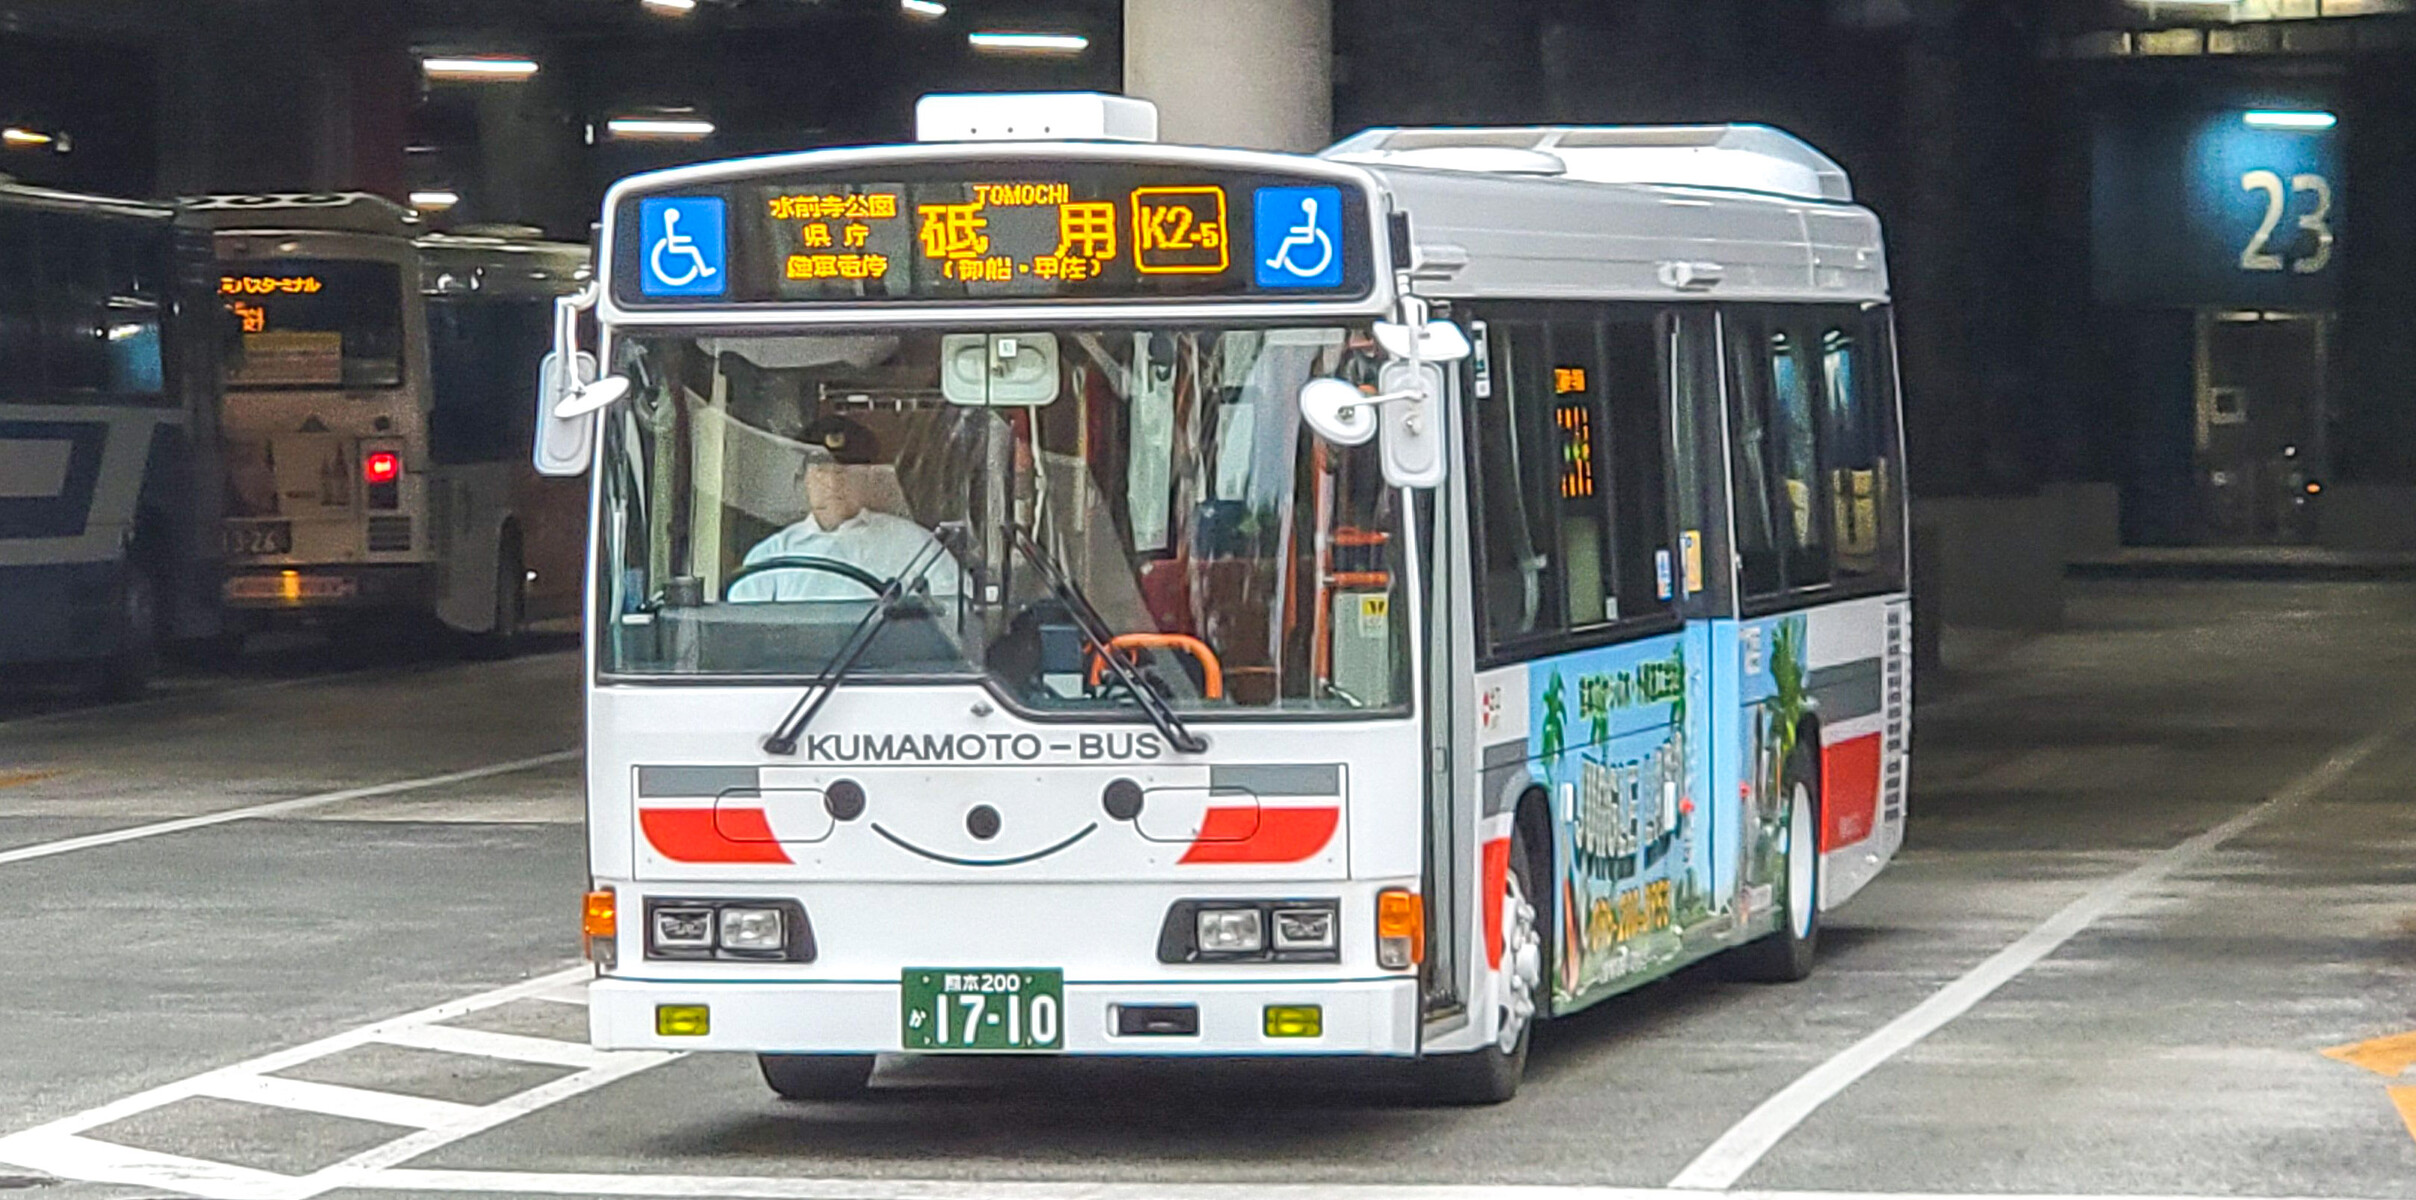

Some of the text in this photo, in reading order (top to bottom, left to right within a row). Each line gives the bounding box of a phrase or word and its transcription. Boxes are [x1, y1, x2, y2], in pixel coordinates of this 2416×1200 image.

[769, 192, 898, 220] 水前寺公園
[973, 183, 1069, 206] TOMOCHI
[2239, 169, 2334, 273] 23
[936, 993, 1058, 1045] 17-10
